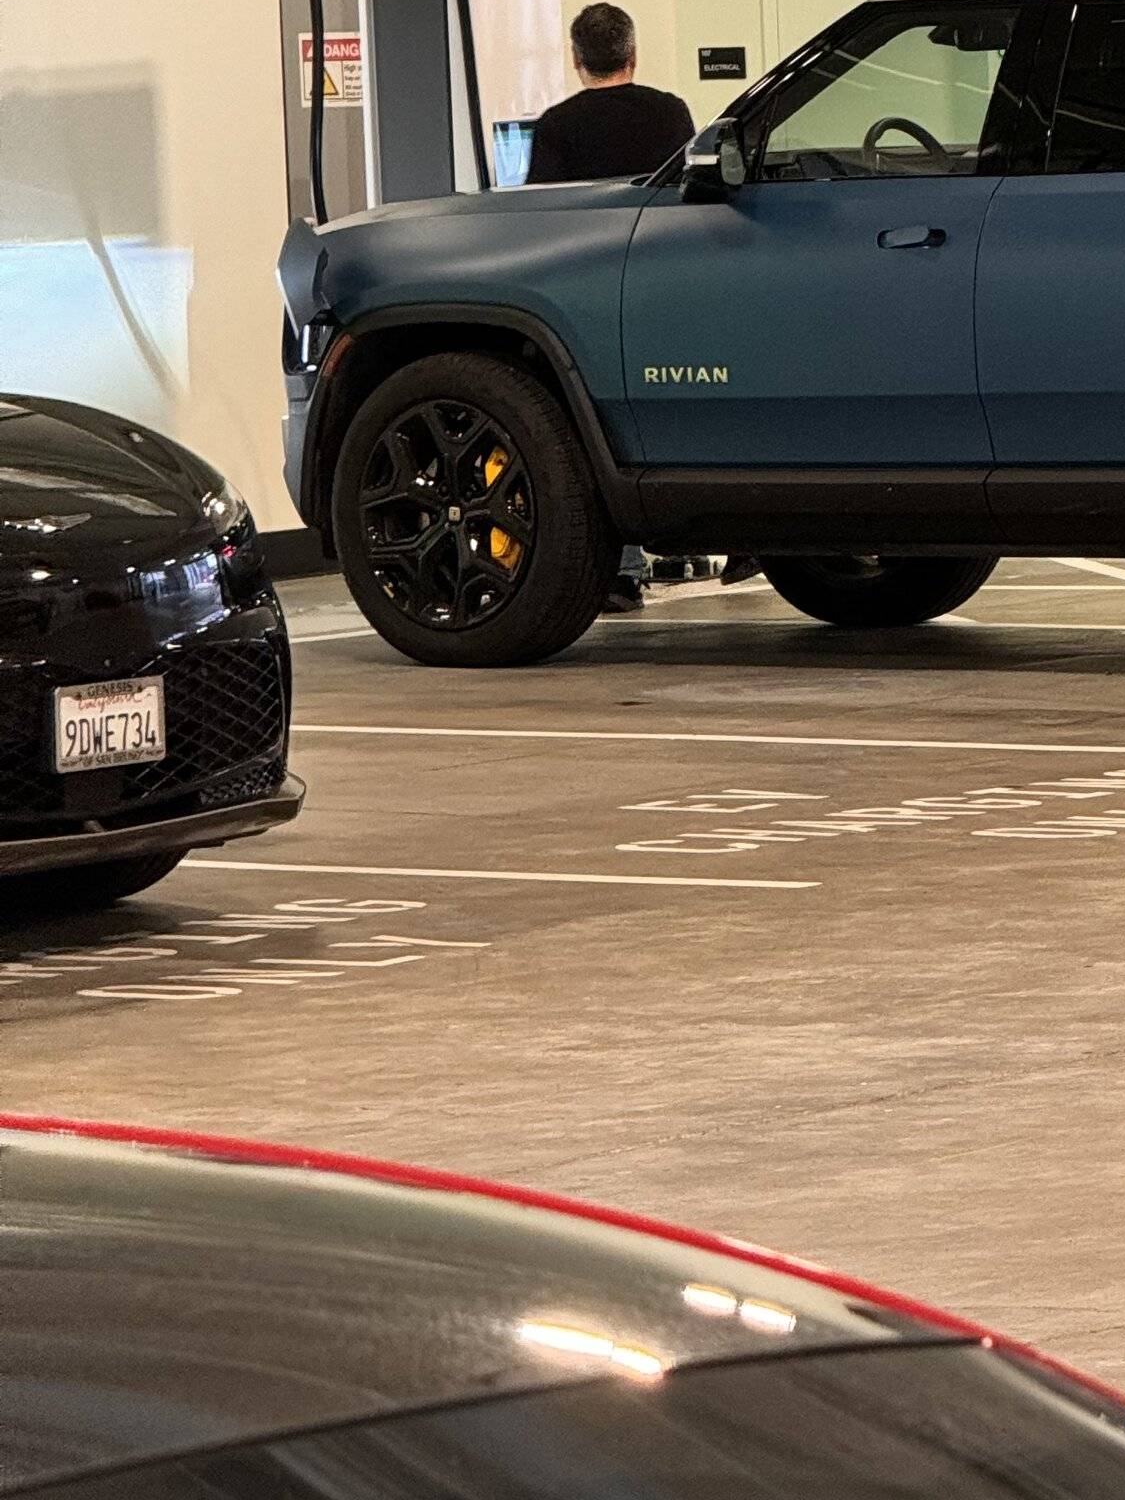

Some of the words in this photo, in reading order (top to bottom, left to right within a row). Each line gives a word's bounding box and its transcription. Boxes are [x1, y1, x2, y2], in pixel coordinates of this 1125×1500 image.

[324, 43, 360, 58] DANG
[703, 64, 741, 72] ELECTRICAL
[644, 366, 729, 383] RIVIAN
[87, 682, 133, 697] GENESIS
[65, 710, 157, 757] 9DWE734
[618, 788, 829, 813] EV
[76, 934, 493, 1000] ONLY
